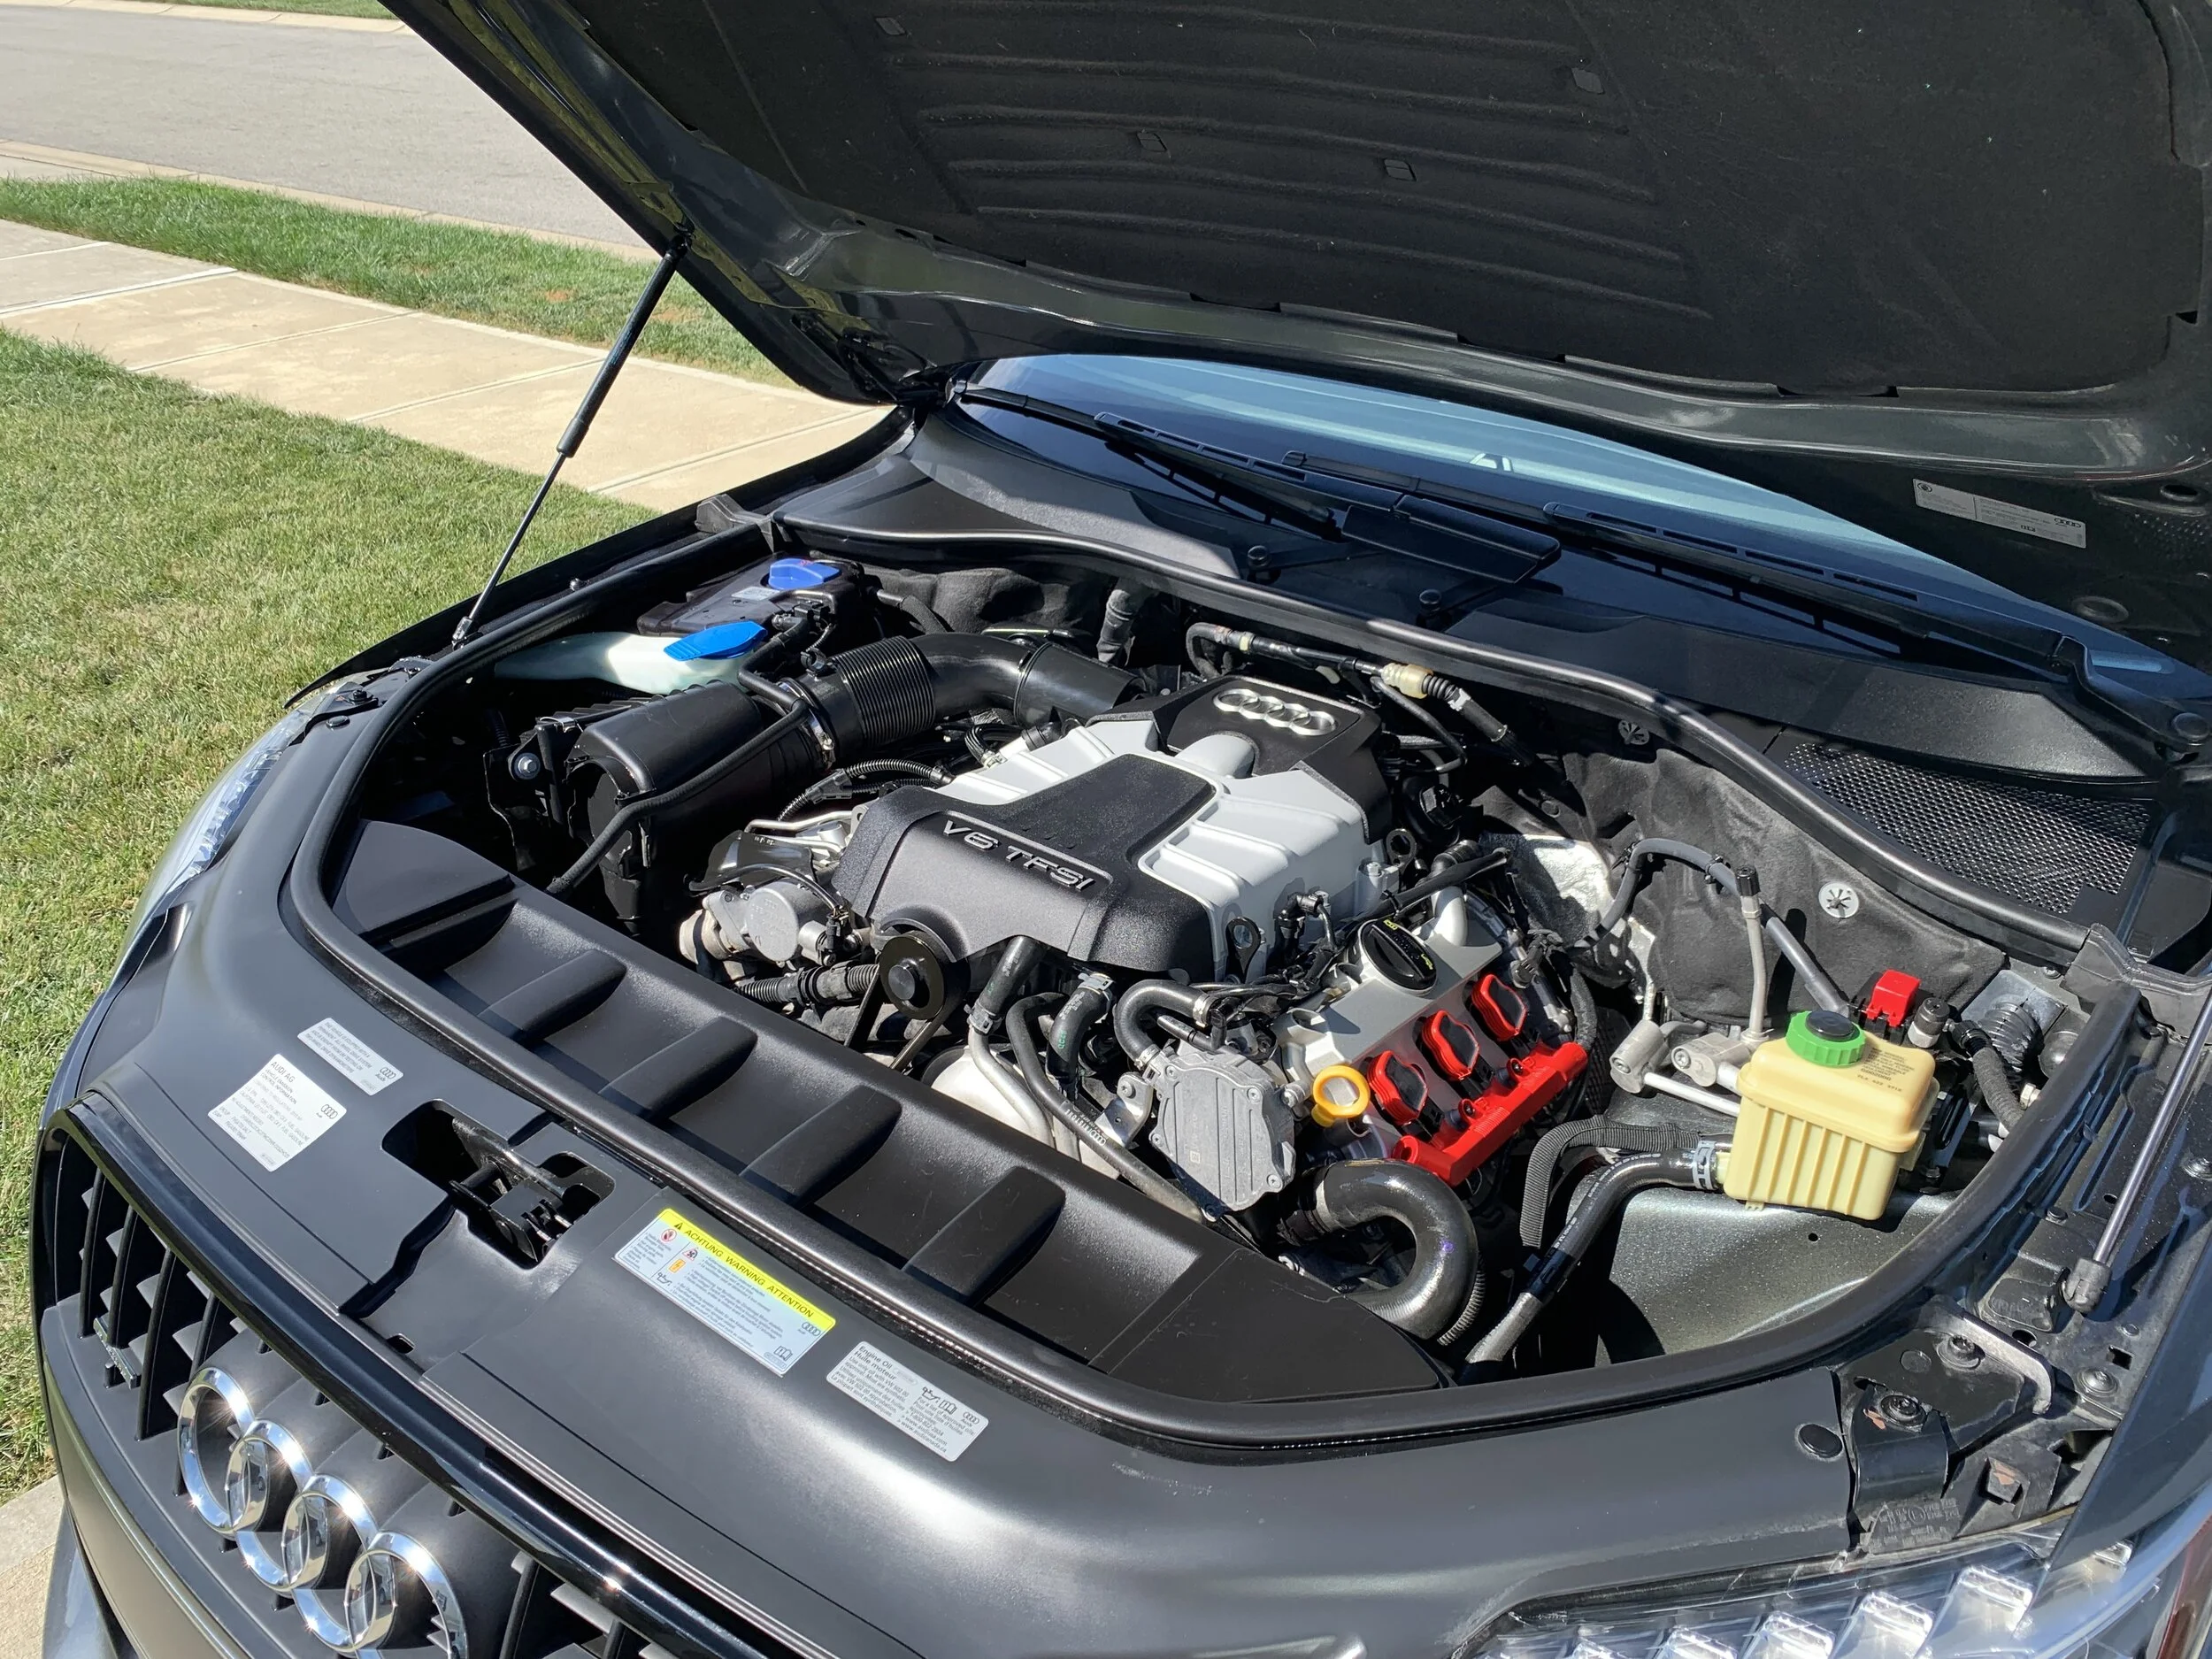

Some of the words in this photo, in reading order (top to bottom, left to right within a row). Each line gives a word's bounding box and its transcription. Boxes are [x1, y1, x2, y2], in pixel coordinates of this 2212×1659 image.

[943, 820, 1000, 850] V6
[1005, 845, 1095, 891] TFSI
[270, 1061, 287, 1075] AUDI
[283, 1071, 296, 1082] AG
[273, 1084, 297, 1104] INFORMATION
[684, 1229, 723, 1256] ACHTUNG
[725, 1256, 765, 1285] WARNING
[767, 1285, 813, 1317] ATTENTION
[853, 1350, 872, 1364] Huile
[871, 1362, 898, 1380] moteur
[857, 1345, 882, 1363] Engine
[880, 1360, 893, 1370] Oil
[856, 1362, 869, 1371] only
[873, 1372, 886, 1381] with
[941, 1412, 965, 1429] approved
[960, 1417, 973, 1427] Audi
